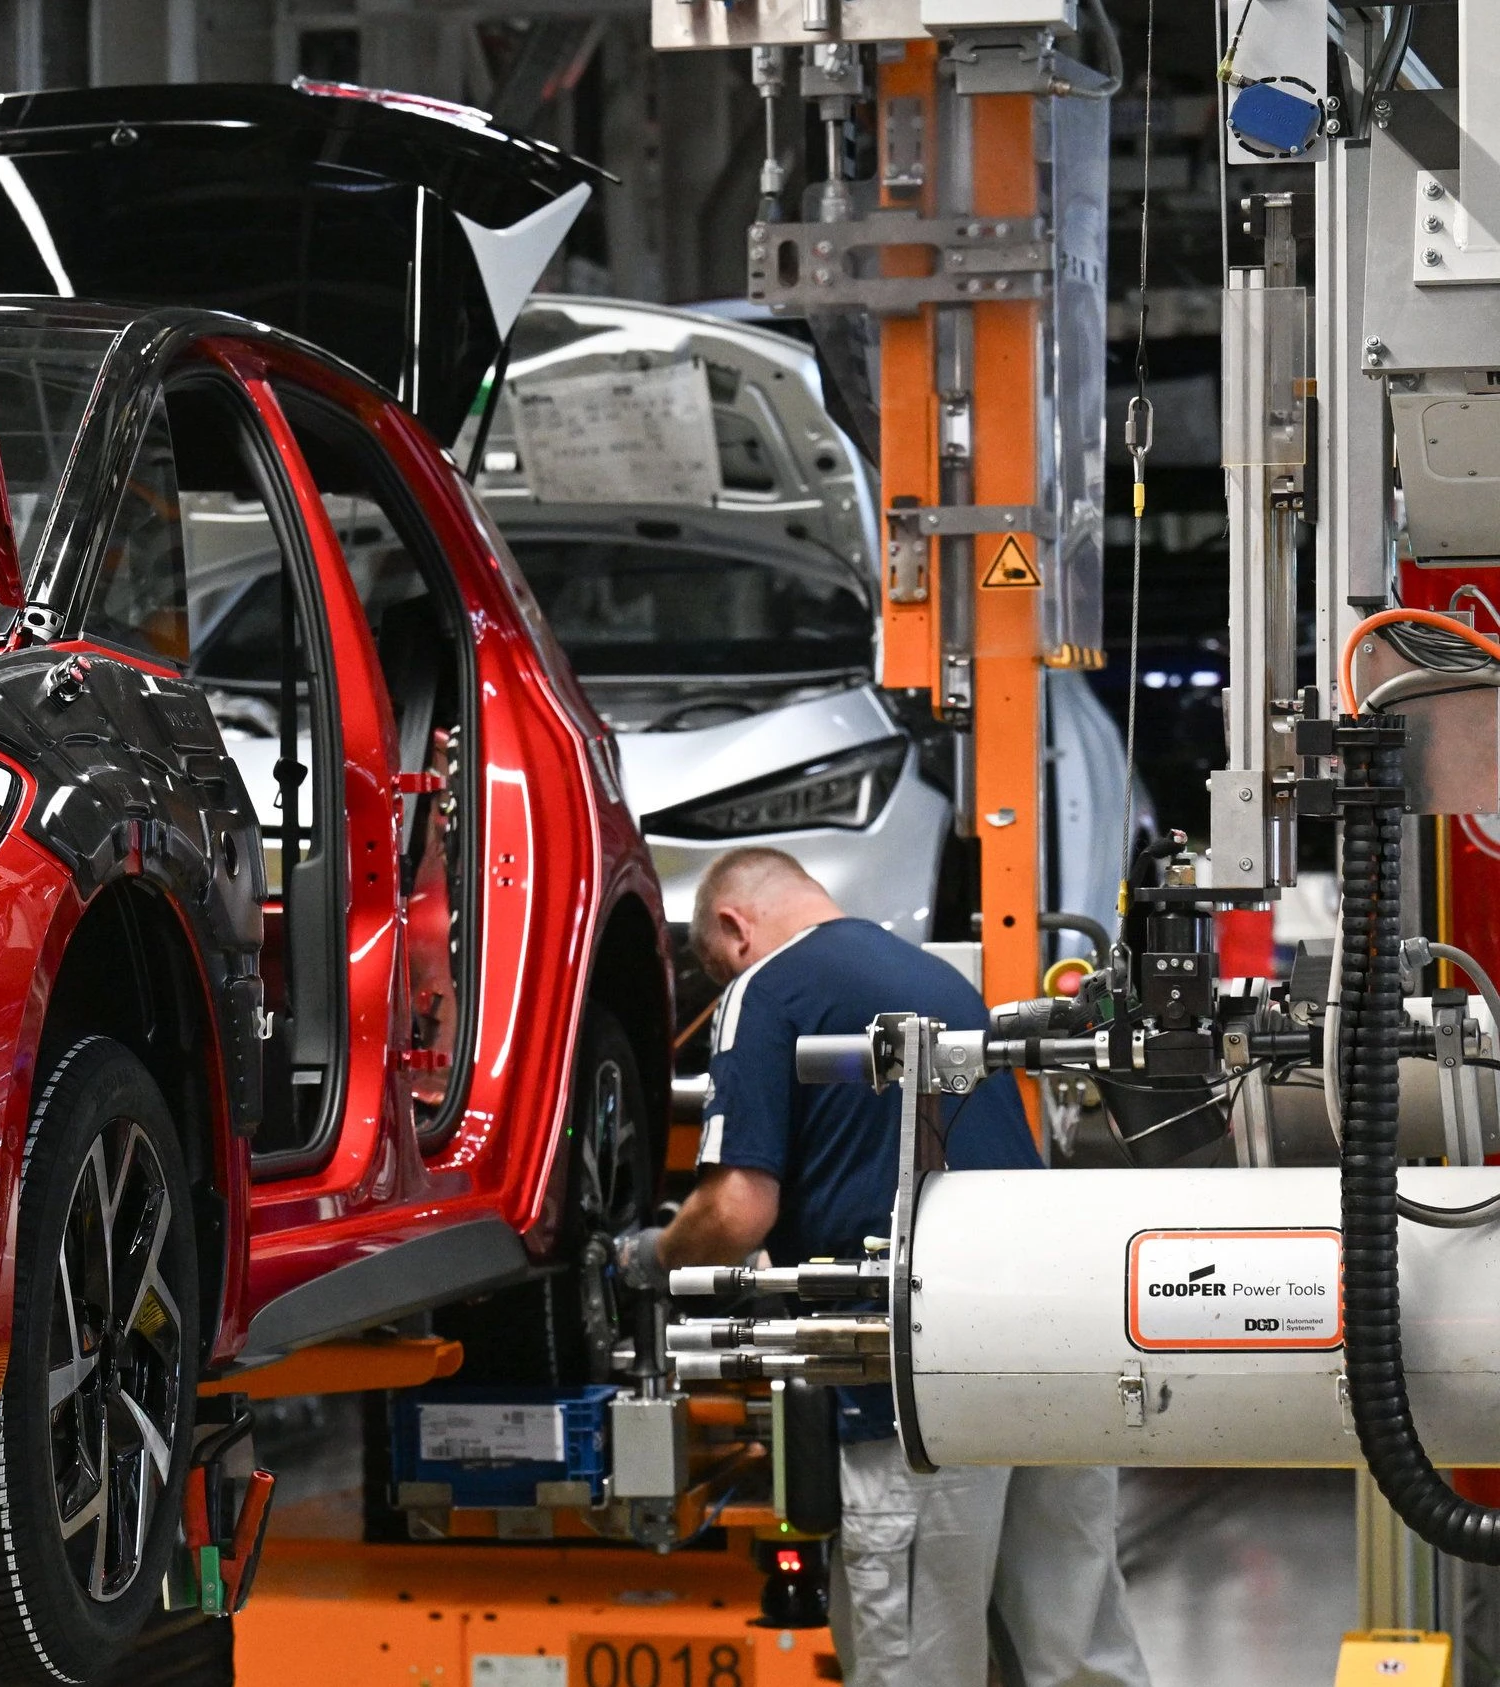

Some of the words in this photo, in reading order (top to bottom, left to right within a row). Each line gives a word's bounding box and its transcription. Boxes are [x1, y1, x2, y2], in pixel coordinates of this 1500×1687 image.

[1149, 1283, 1226, 1297] COOPER
[1232, 1283, 1280, 1297] Power
[1286, 1282, 1326, 1296] Tools
[584, 1642, 743, 1687] 0018
